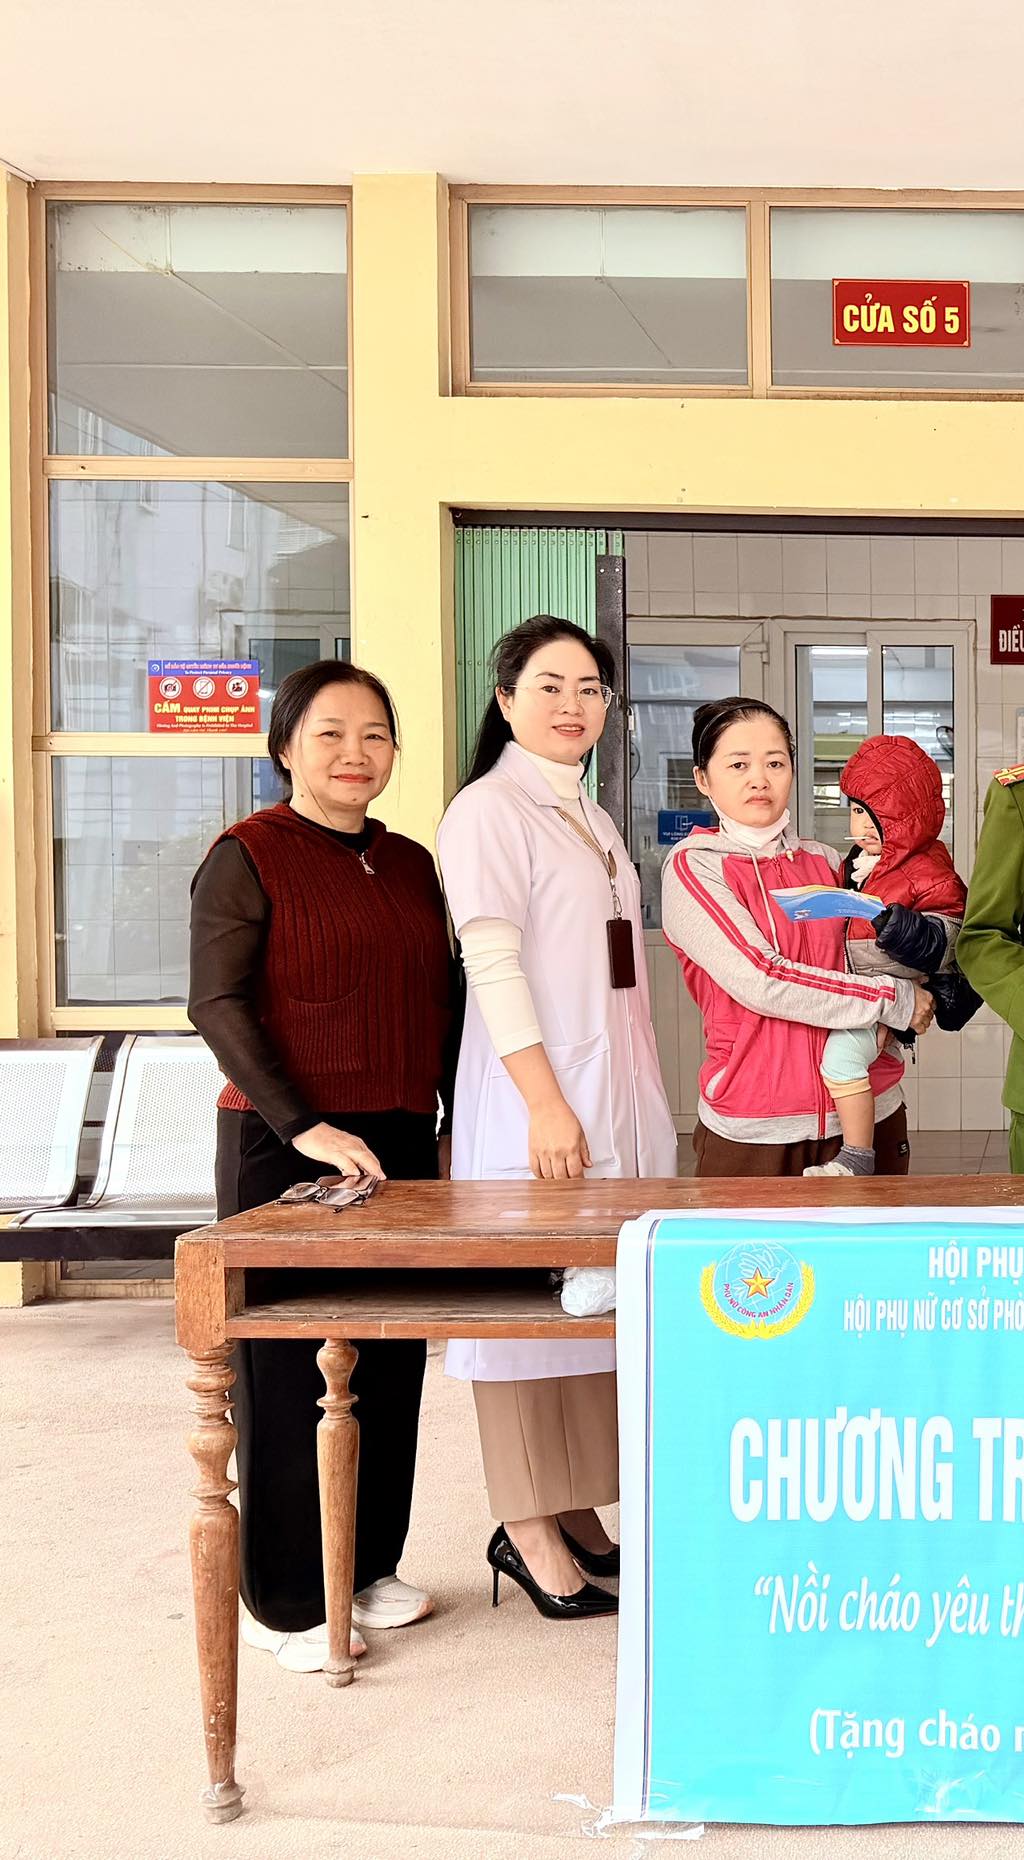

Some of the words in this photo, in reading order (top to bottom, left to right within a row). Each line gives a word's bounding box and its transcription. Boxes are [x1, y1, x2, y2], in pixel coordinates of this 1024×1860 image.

[843, 292, 895, 333] CỬA
[902, 295, 938, 334] SỐ
[944, 306, 960, 334] 5
[154, 700, 181, 713] CẤM
[928, 1240, 968, 1285] HỘI
[976, 1246, 1024, 1285] PHỤ
[843, 1293, 871, 1339] HỘI
[875, 1299, 909, 1338] PHỤ
[913, 1291, 939, 1332] NỮ
[941, 1296, 963, 1331] CƠ
[967, 1284, 991, 1331] SỞ
[728, 1406, 954, 1523] CHƯƠNG
[839, 1573, 921, 1633] cháo
[925, 1574, 991, 1648] yêu
[809, 1707, 905, 1759] (Tặng
[918, 1708, 1001, 1752] cháo
